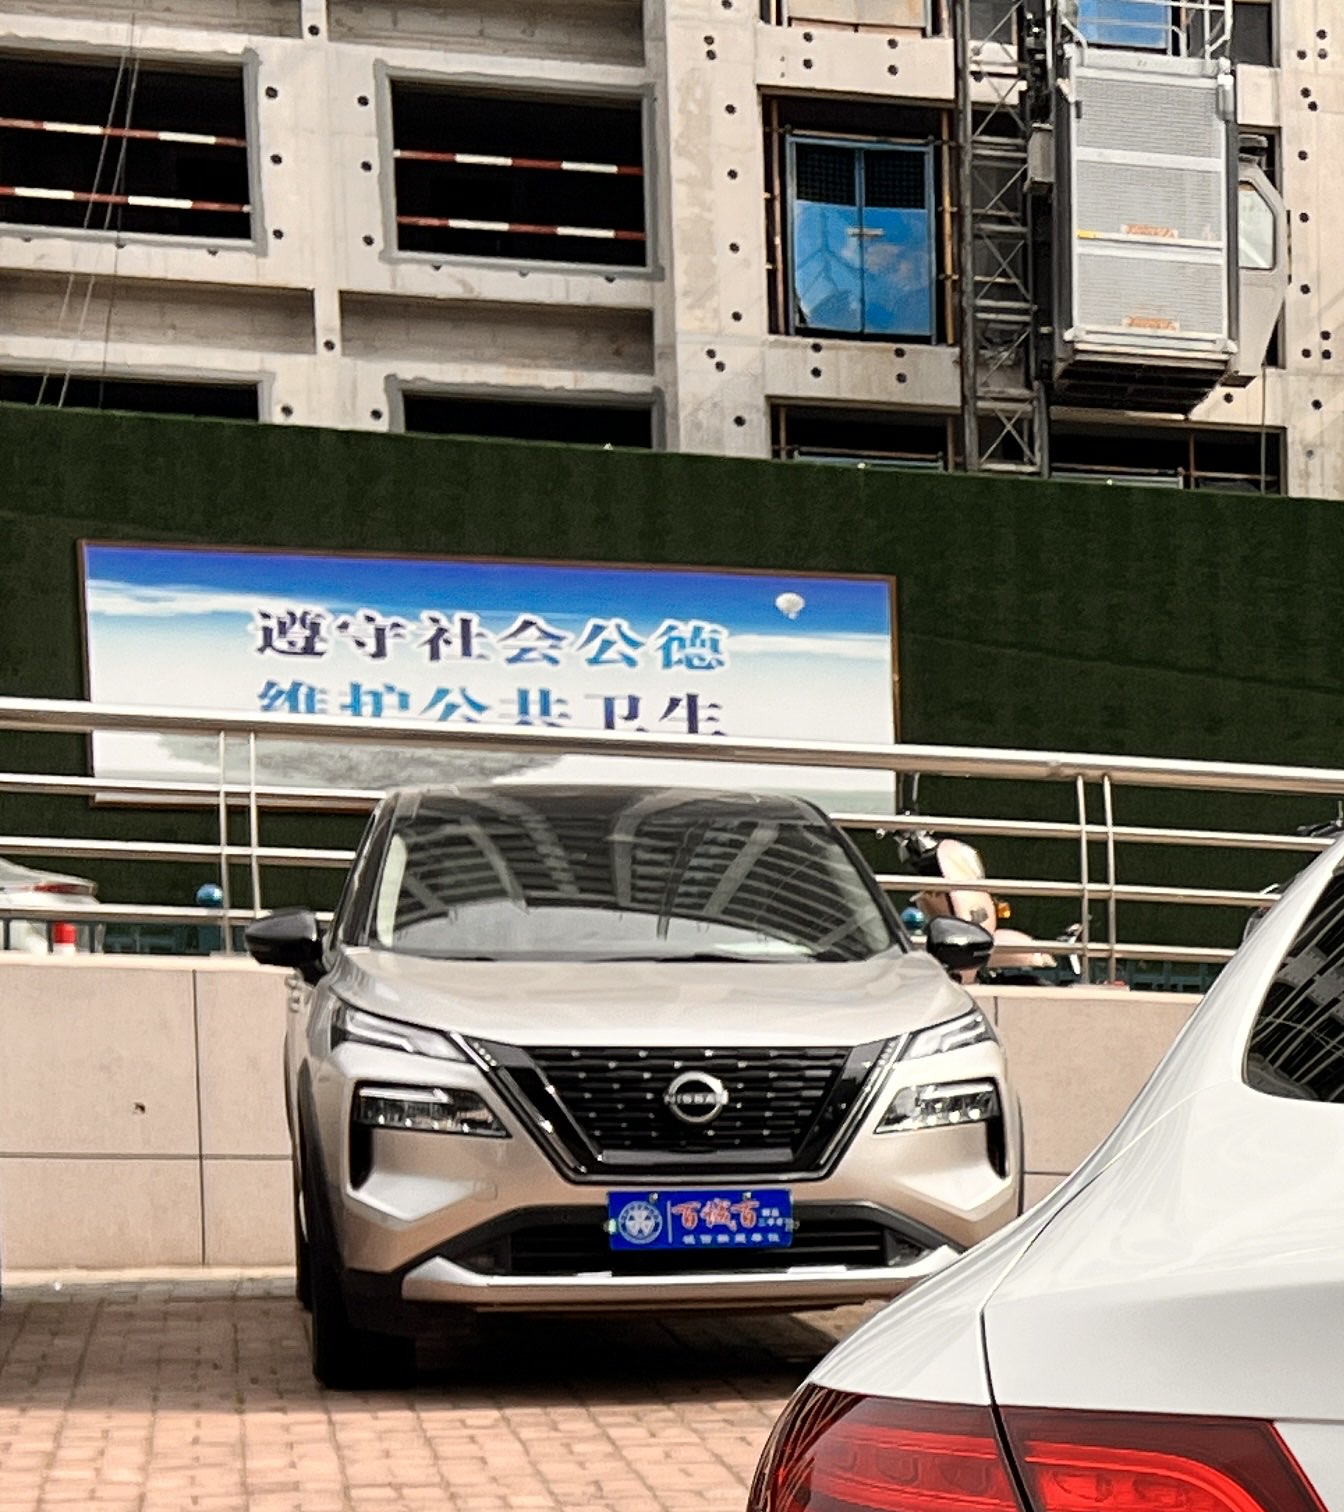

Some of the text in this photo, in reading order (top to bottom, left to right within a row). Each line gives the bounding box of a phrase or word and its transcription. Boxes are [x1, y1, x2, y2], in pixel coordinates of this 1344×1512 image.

[258, 608, 728, 669] 遵守社会公德
